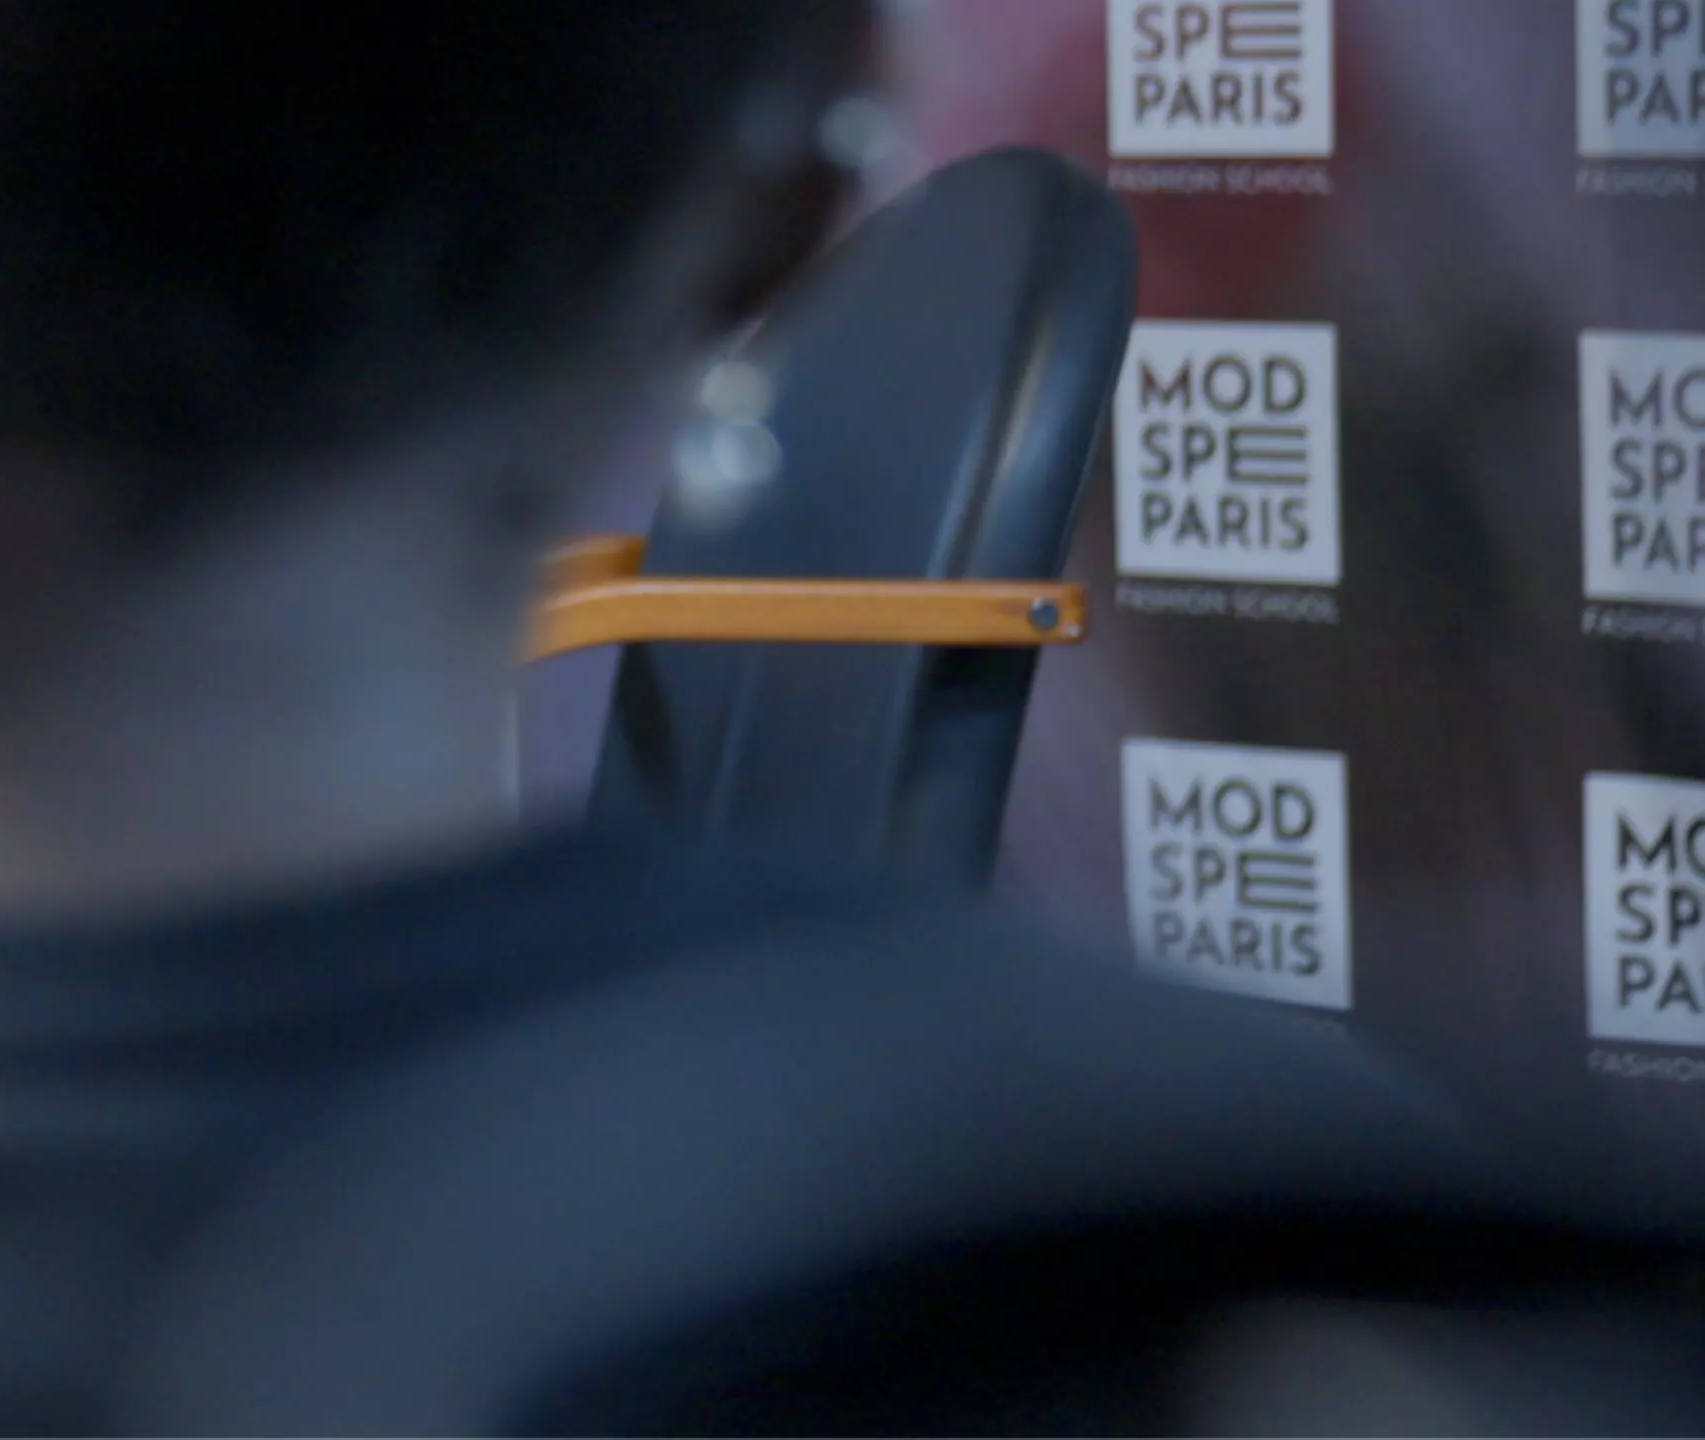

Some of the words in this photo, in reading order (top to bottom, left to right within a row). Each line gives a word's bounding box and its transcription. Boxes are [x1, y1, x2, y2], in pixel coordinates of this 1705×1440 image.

[1134, 0, 1302, 62] SPE
[1135, 68, 1303, 127] PARIS
[1140, 354, 1307, 414] MOD
[1141, 423, 1309, 485] SPE
[1609, 436, 1705, 505] SP
[1141, 491, 1310, 552] PARIS
[1149, 776, 1316, 841] MOD
[1150, 842, 1319, 911] SPE
[1153, 913, 1322, 977] PARIS
